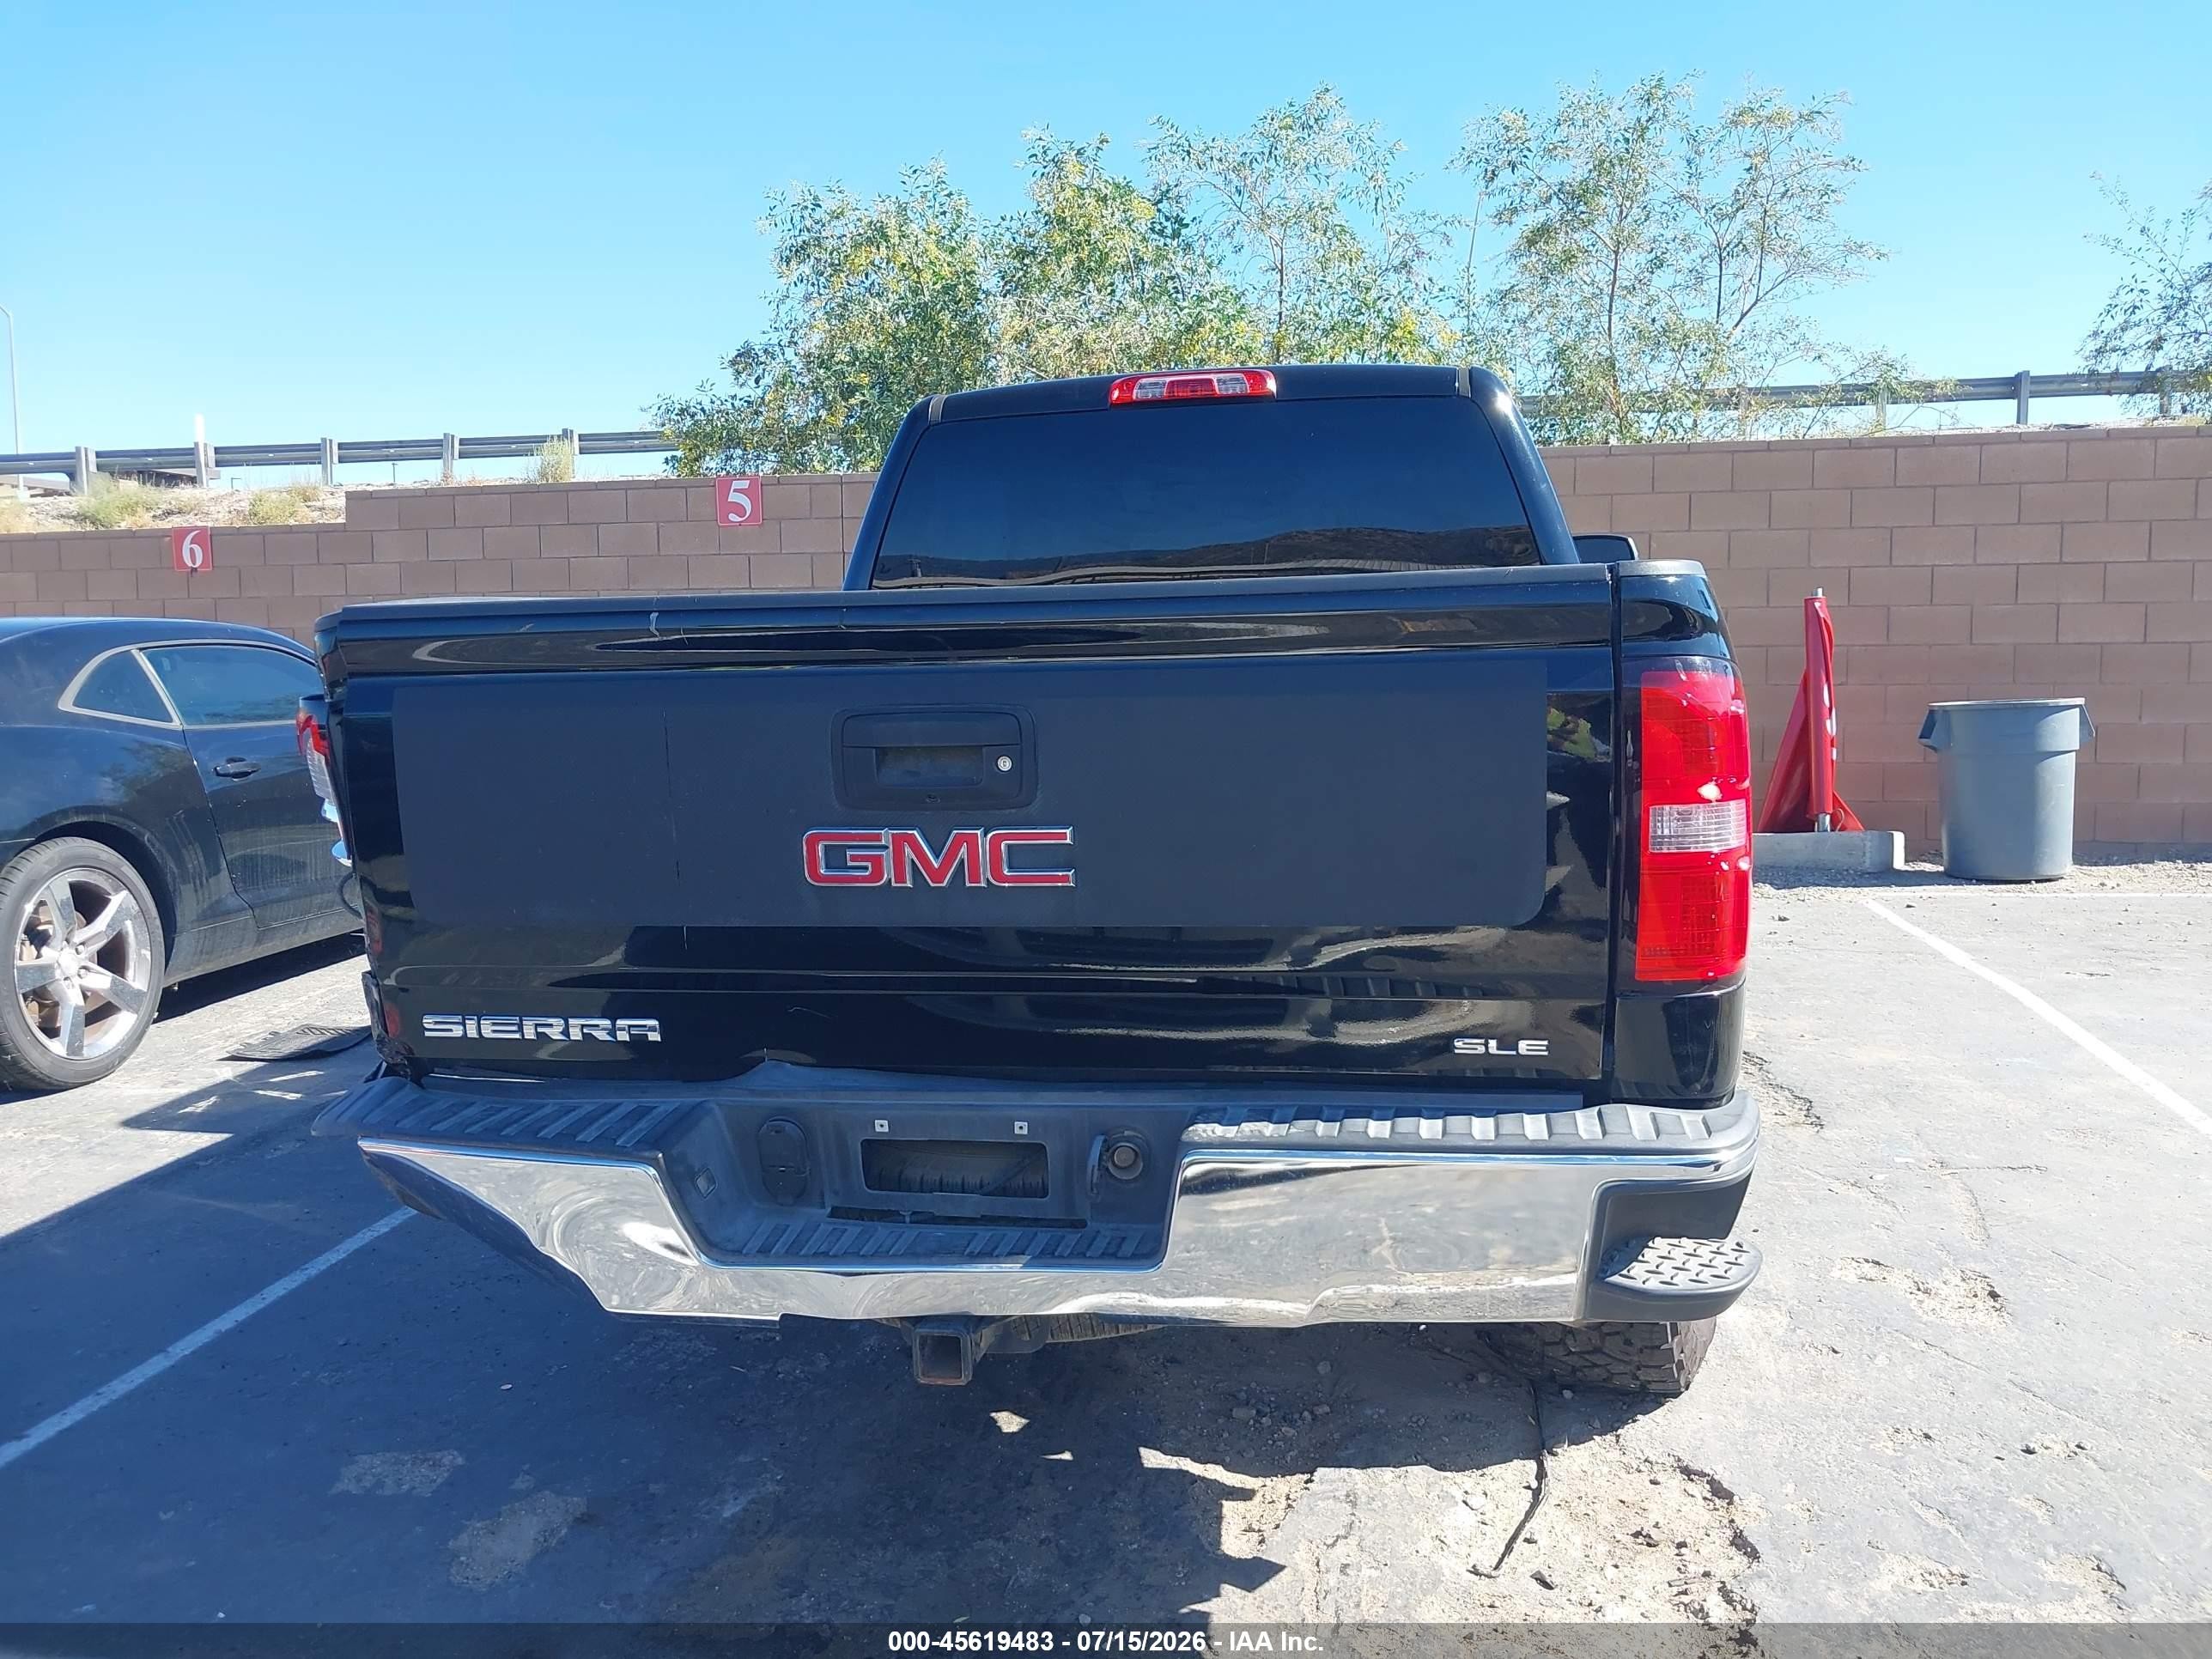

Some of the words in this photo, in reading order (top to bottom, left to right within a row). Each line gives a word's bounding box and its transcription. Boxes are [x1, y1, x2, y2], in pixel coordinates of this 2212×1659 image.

[727, 480, 752, 522] 5
[182, 530, 203, 568] 6
[802, 826, 1076, 887] GMC
[422, 1014, 661, 1042] SIERRA
[1454, 1038, 1549, 1055] SLE
